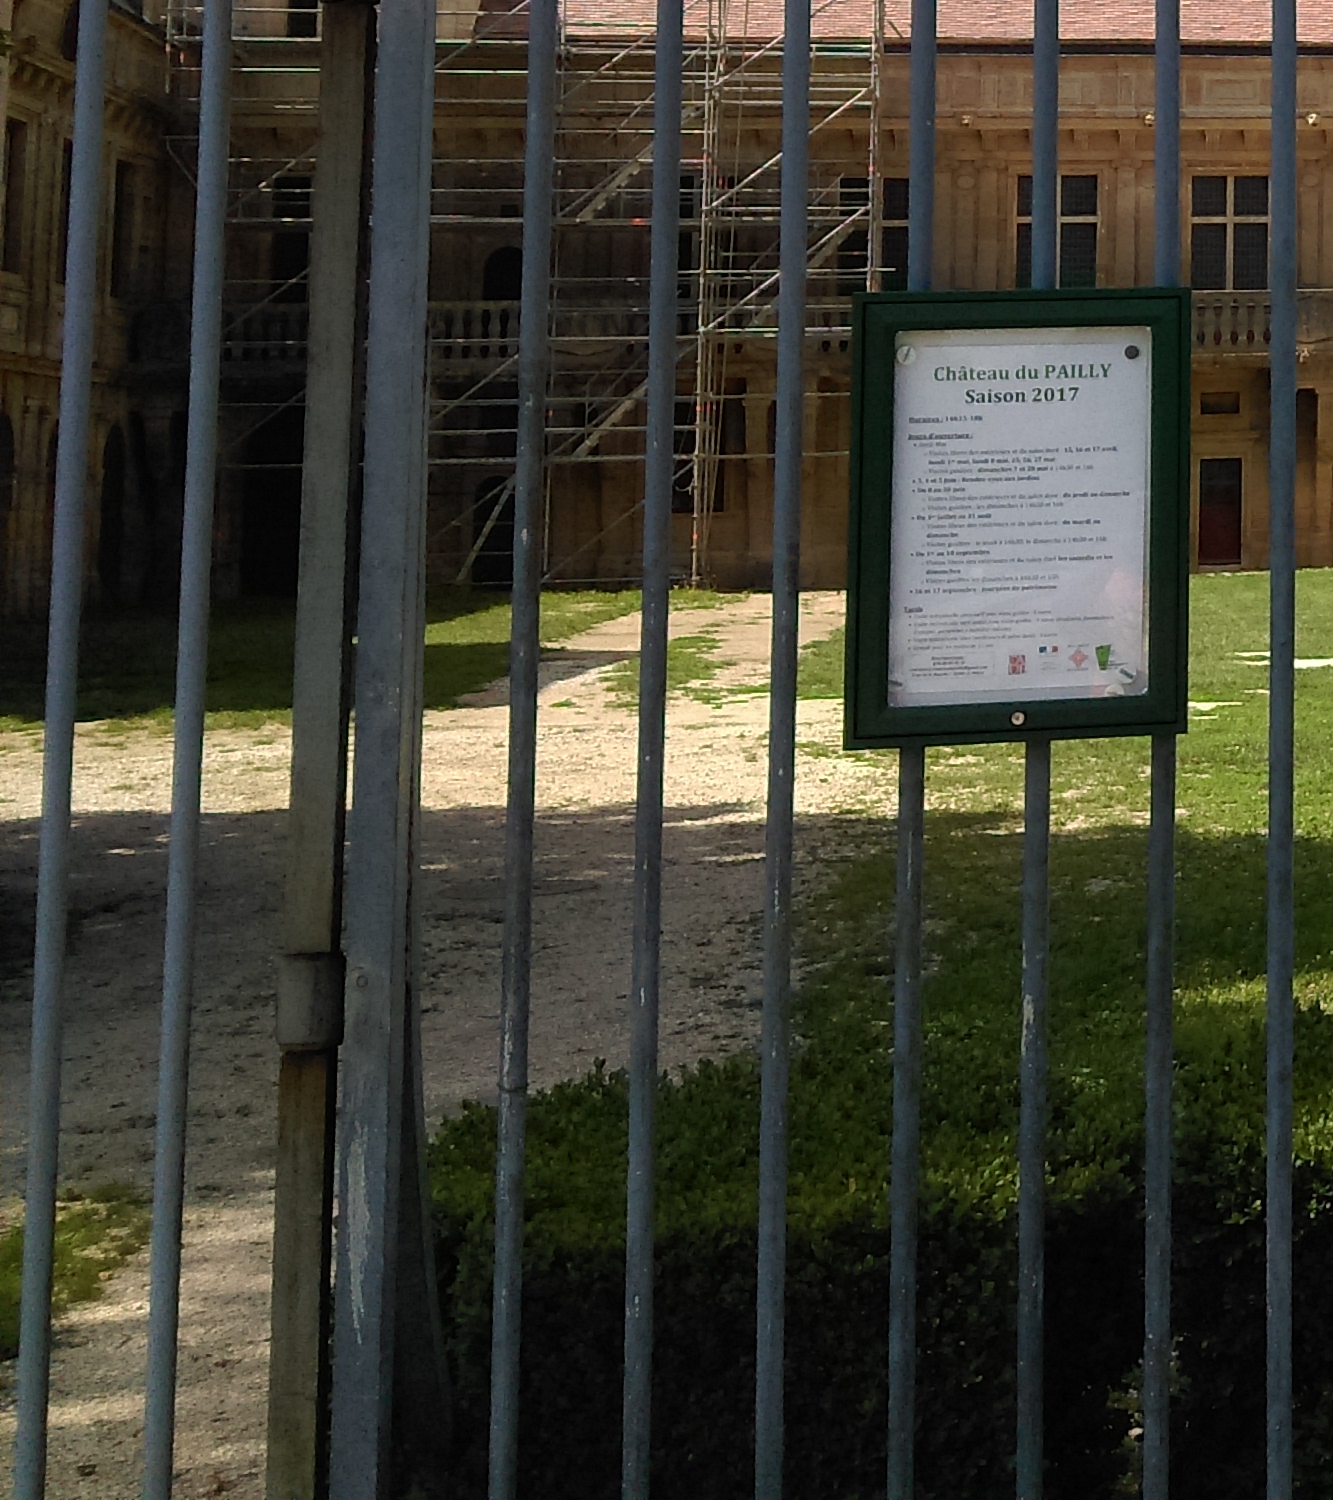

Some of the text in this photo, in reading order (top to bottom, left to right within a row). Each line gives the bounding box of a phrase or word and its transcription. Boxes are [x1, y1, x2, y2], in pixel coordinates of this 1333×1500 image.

[934, 363, 1112, 382] Château du PAILLY
[965, 387, 1079, 404] Saison 2017
